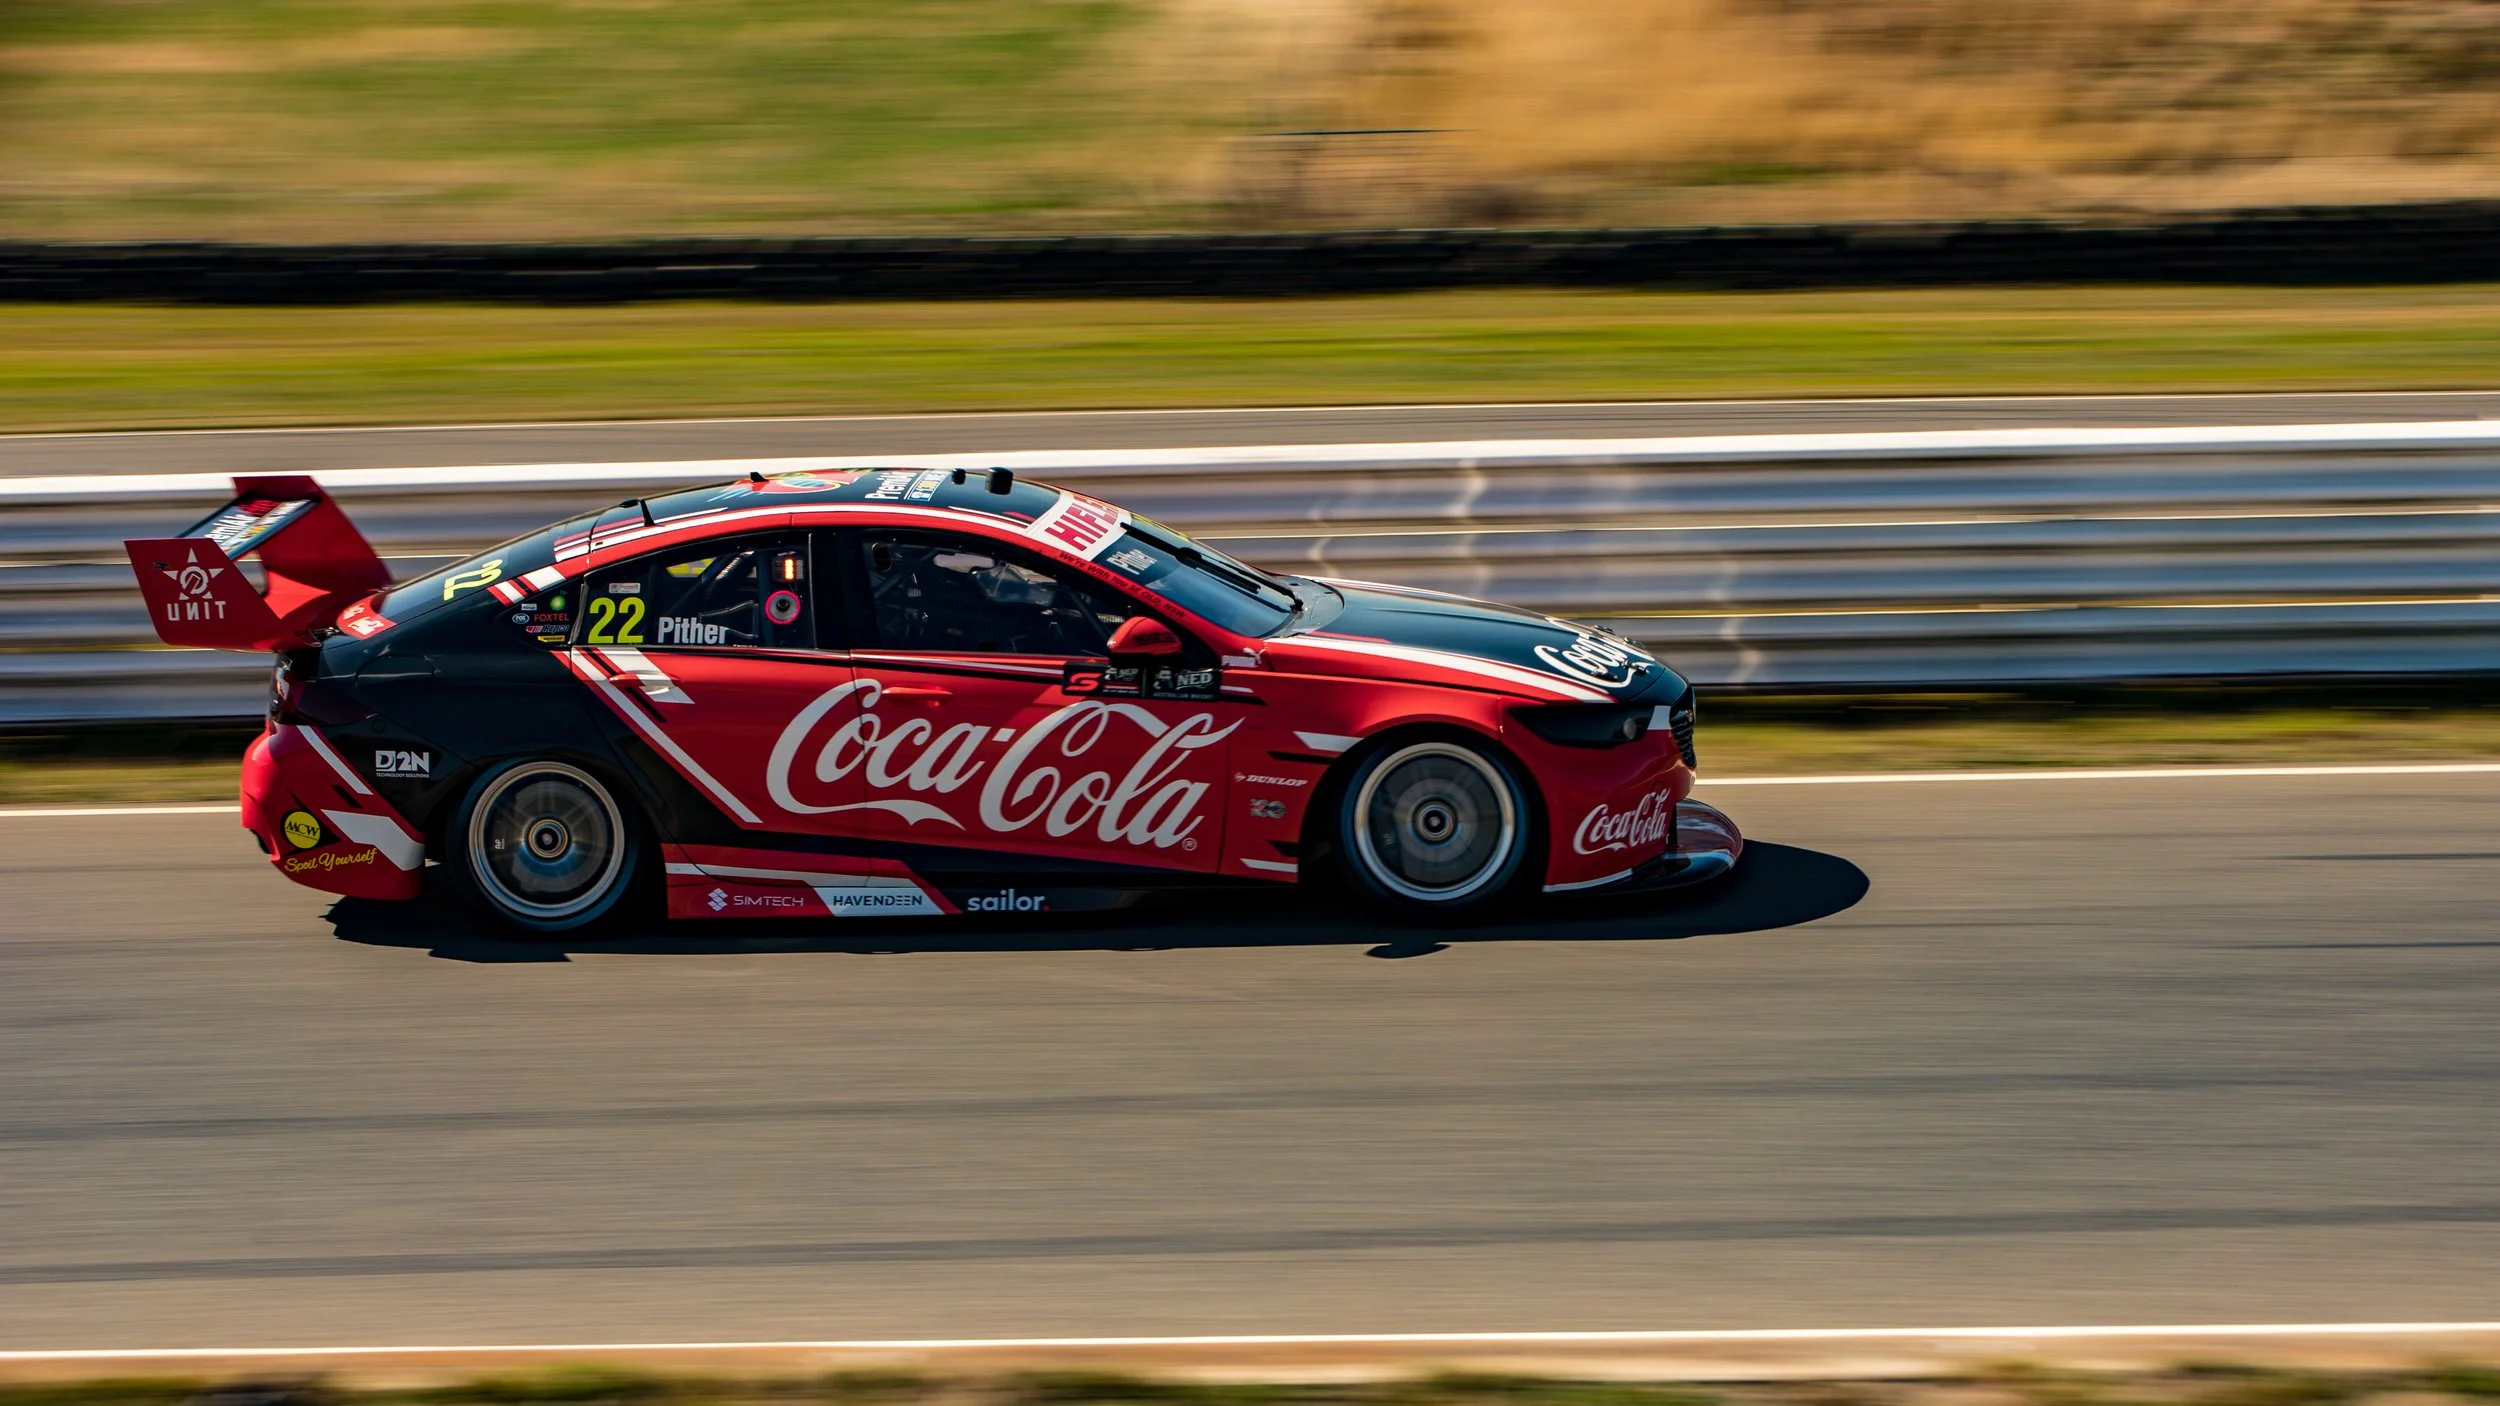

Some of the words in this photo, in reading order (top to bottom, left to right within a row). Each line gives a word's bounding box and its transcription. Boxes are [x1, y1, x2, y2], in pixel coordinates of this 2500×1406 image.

[534, 613, 569, 621] FOXTEL
[588, 597, 646, 643] 22
[658, 616, 728, 644] Pither
[1177, 672, 1214, 687] NED
[766, 678, 1246, 848] Coca-Cola
[1246, 774, 1308, 787] DUNLOP
[1573, 786, 1671, 855] Coca-Cola
[286, 821, 320, 837] MCW
[284, 855, 319, 874] Spoil
[318, 847, 378, 872] Yourself
[733, 895, 804, 907] SIMTECH
[833, 895, 923, 906] HAVENDEEN
